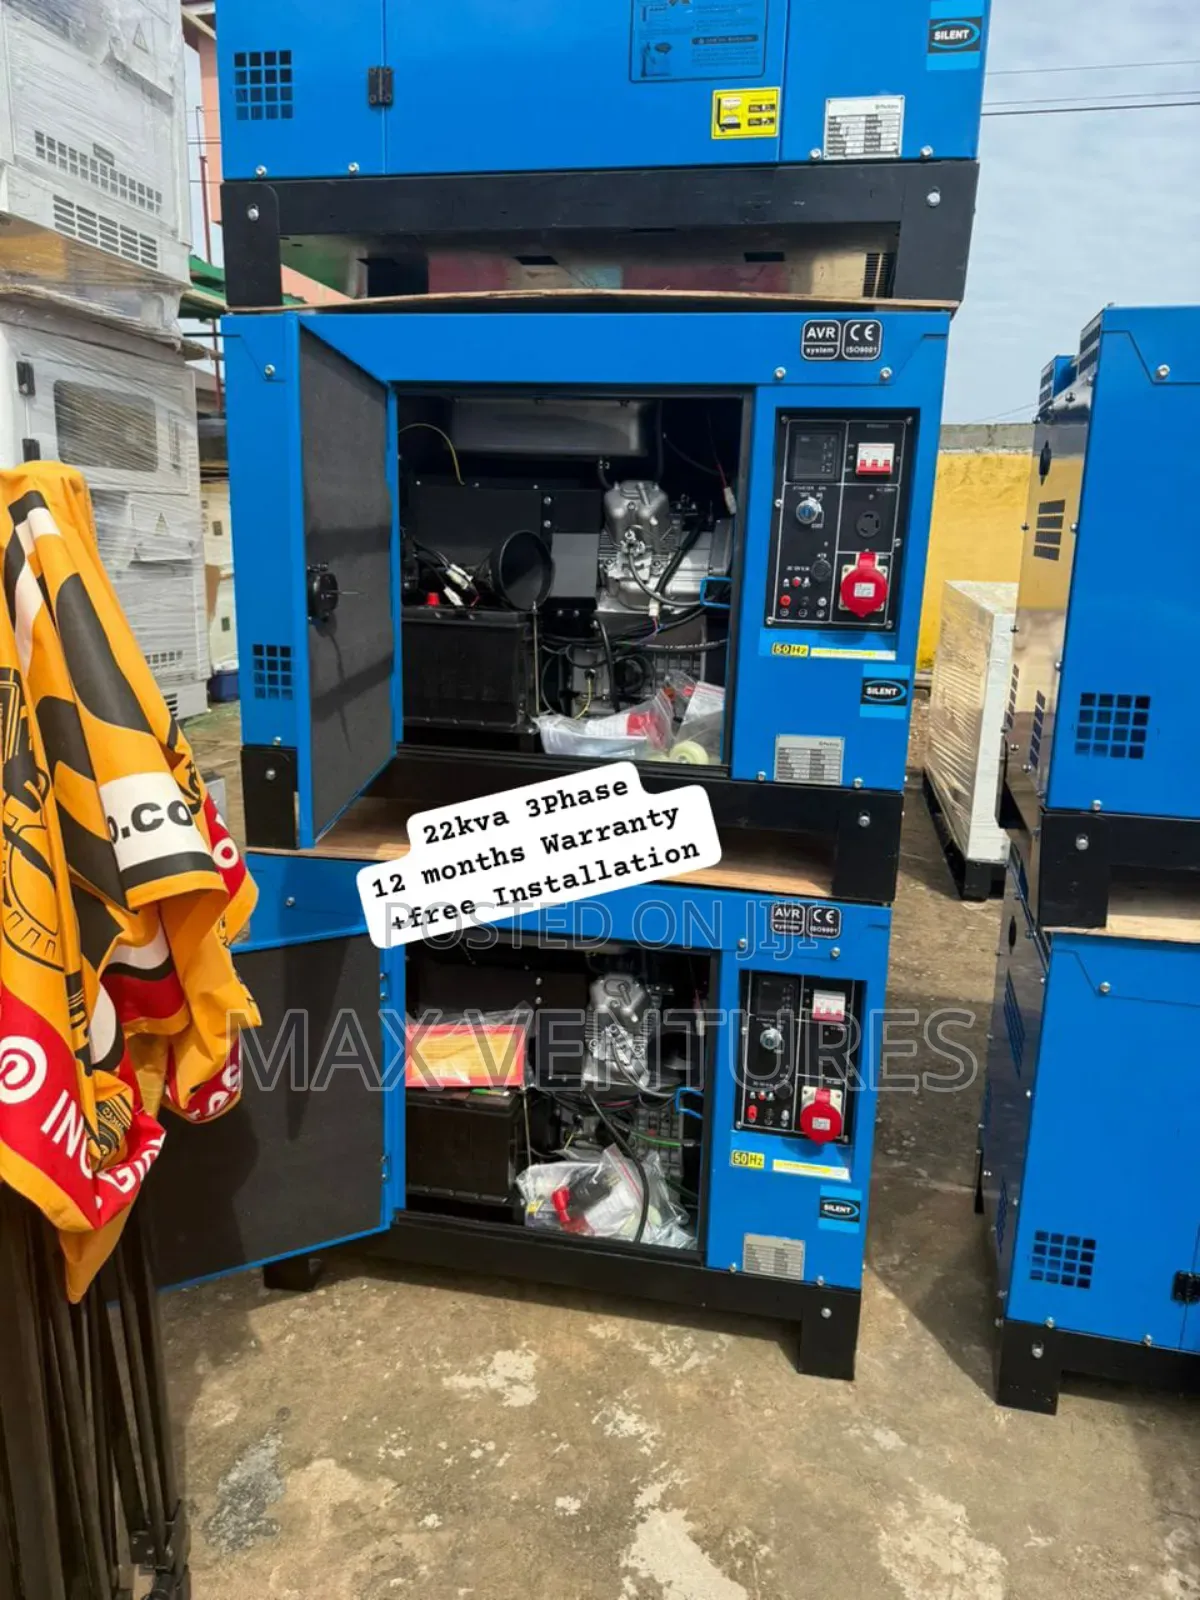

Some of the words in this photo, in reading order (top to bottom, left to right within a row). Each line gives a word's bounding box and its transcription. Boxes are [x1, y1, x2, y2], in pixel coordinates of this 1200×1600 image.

[934, 29, 970, 40] SILENT
[806, 326, 836, 339] AVR
[850, 324, 875, 341] CE
[806, 346, 835, 356] system
[866, 686, 897, 696] SILENT
[775, 907, 801, 919] AVR
[813, 909, 835, 924] CE
[733, 1151, 763, 1167] 50Hz
[824, 1203, 852, 1214] SILENT
